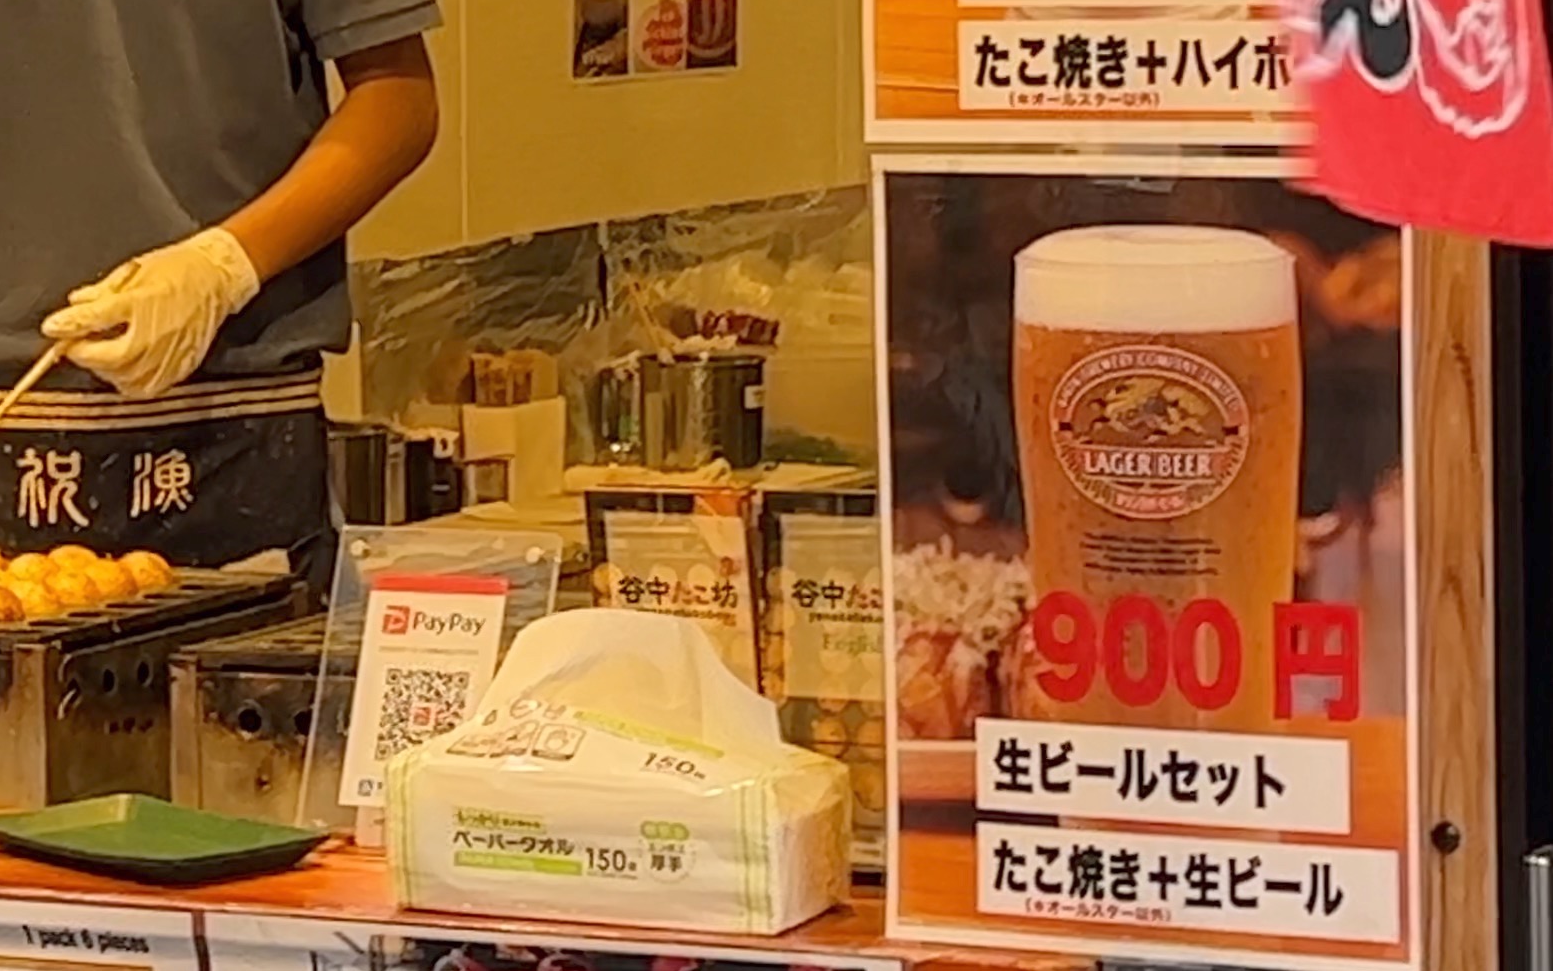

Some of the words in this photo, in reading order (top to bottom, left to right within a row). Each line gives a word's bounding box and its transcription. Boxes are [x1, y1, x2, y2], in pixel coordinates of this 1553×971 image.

[1084, 451, 1152, 477] LAGER
[1157, 453, 1213, 478] BEER
[618, 575, 738, 609] 谷中たこ坊
[412, 610, 487, 637] PayPay
[993, 737, 1286, 809] 生ビールセット
[453, 830, 575, 856] ペーパータオル
[38, 927, 78, 949] pack
[97, 931, 150, 954] pieces
